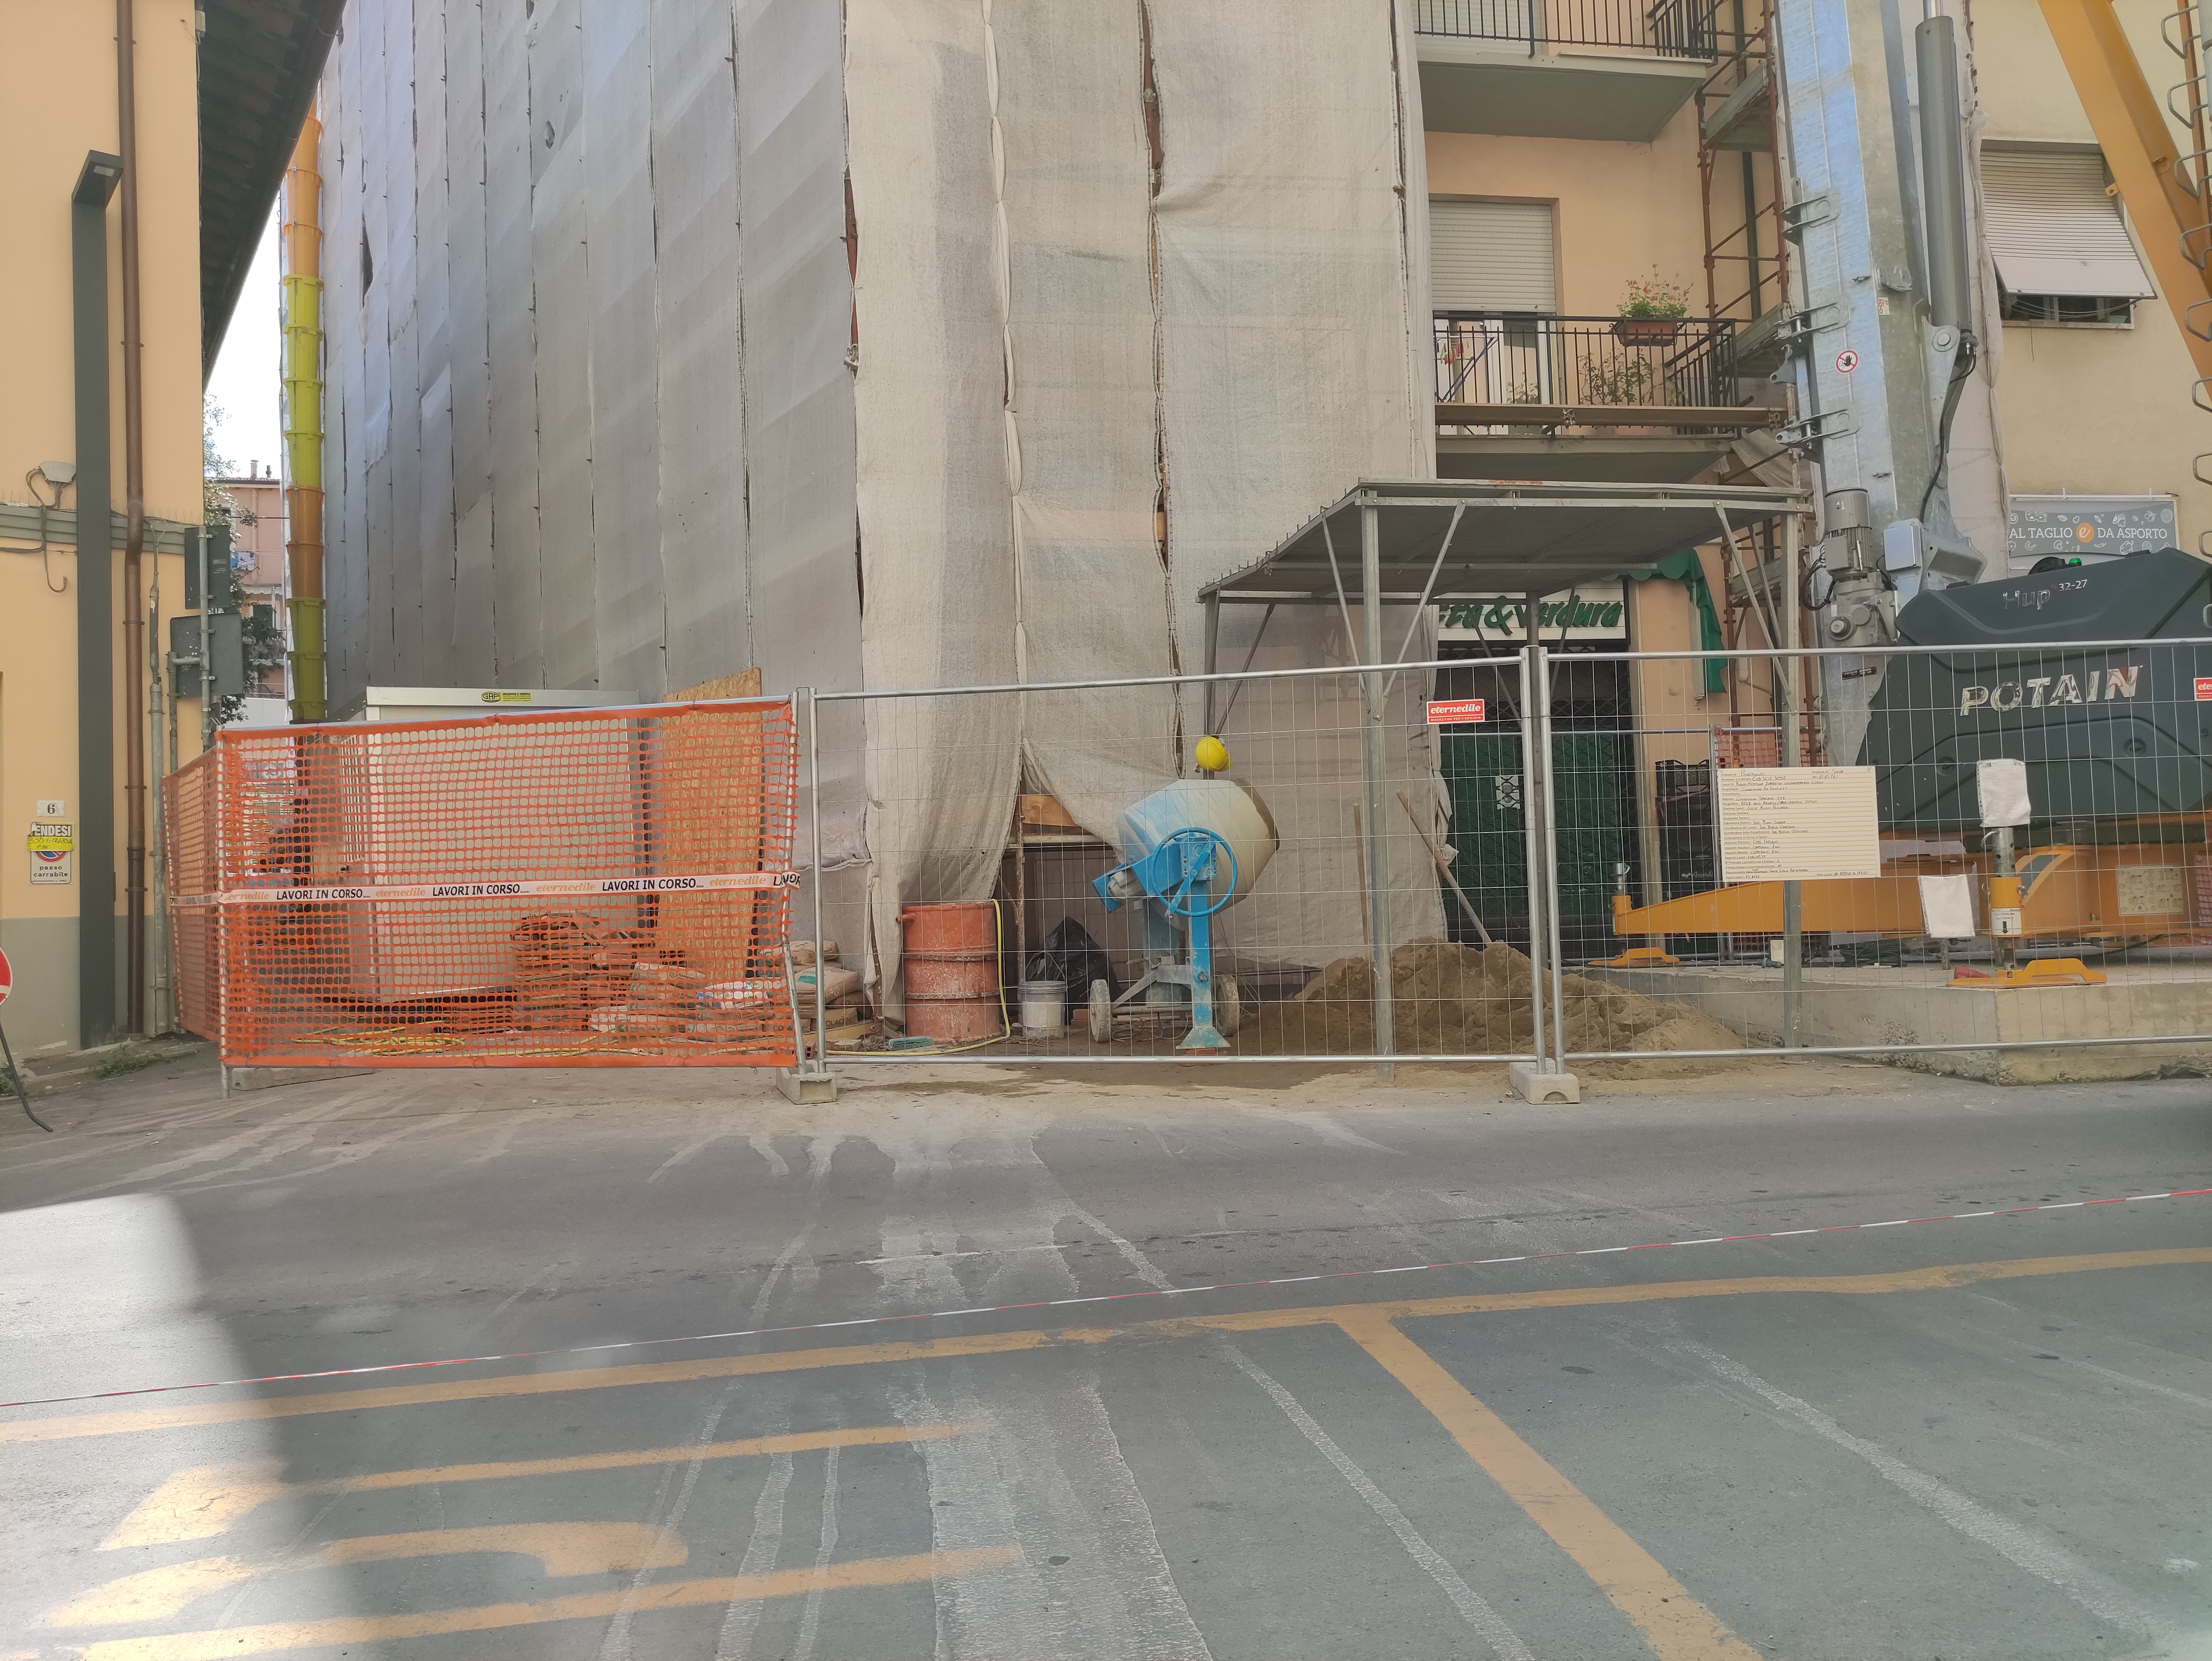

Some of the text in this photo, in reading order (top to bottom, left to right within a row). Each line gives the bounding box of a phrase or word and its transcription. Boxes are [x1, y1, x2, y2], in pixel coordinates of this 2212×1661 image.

[2009, 527, 2168, 539] AL TAGLIO e DA ASPORTO
[2002, 579, 2088, 610] Hup 32-27
[1960, 666, 2139, 717] POTAIN
[1431, 704, 1481, 714] eternedile
[47, 803, 55, 814] 6
[33, 825, 72, 837] ENDESI
[276, 890, 314, 901] LAVORI
[315, 889, 329, 900] IN
[332, 888, 363, 900] CORSO
[376, 887, 426, 898] eternedile
[432, 886, 470, 897] LAVORI
[471, 885, 485, 896] IN
[486, 883, 520, 895] CORSO
[536, 882, 596, 893] eternedile
[602, 880, 640, 892] LAVORI
[642, 879, 655, 891] IN
[658, 878, 697, 890] CORSO
[709, 875, 766, 887] eternedile
[825, 1017, 852, 1027] OLACEM
